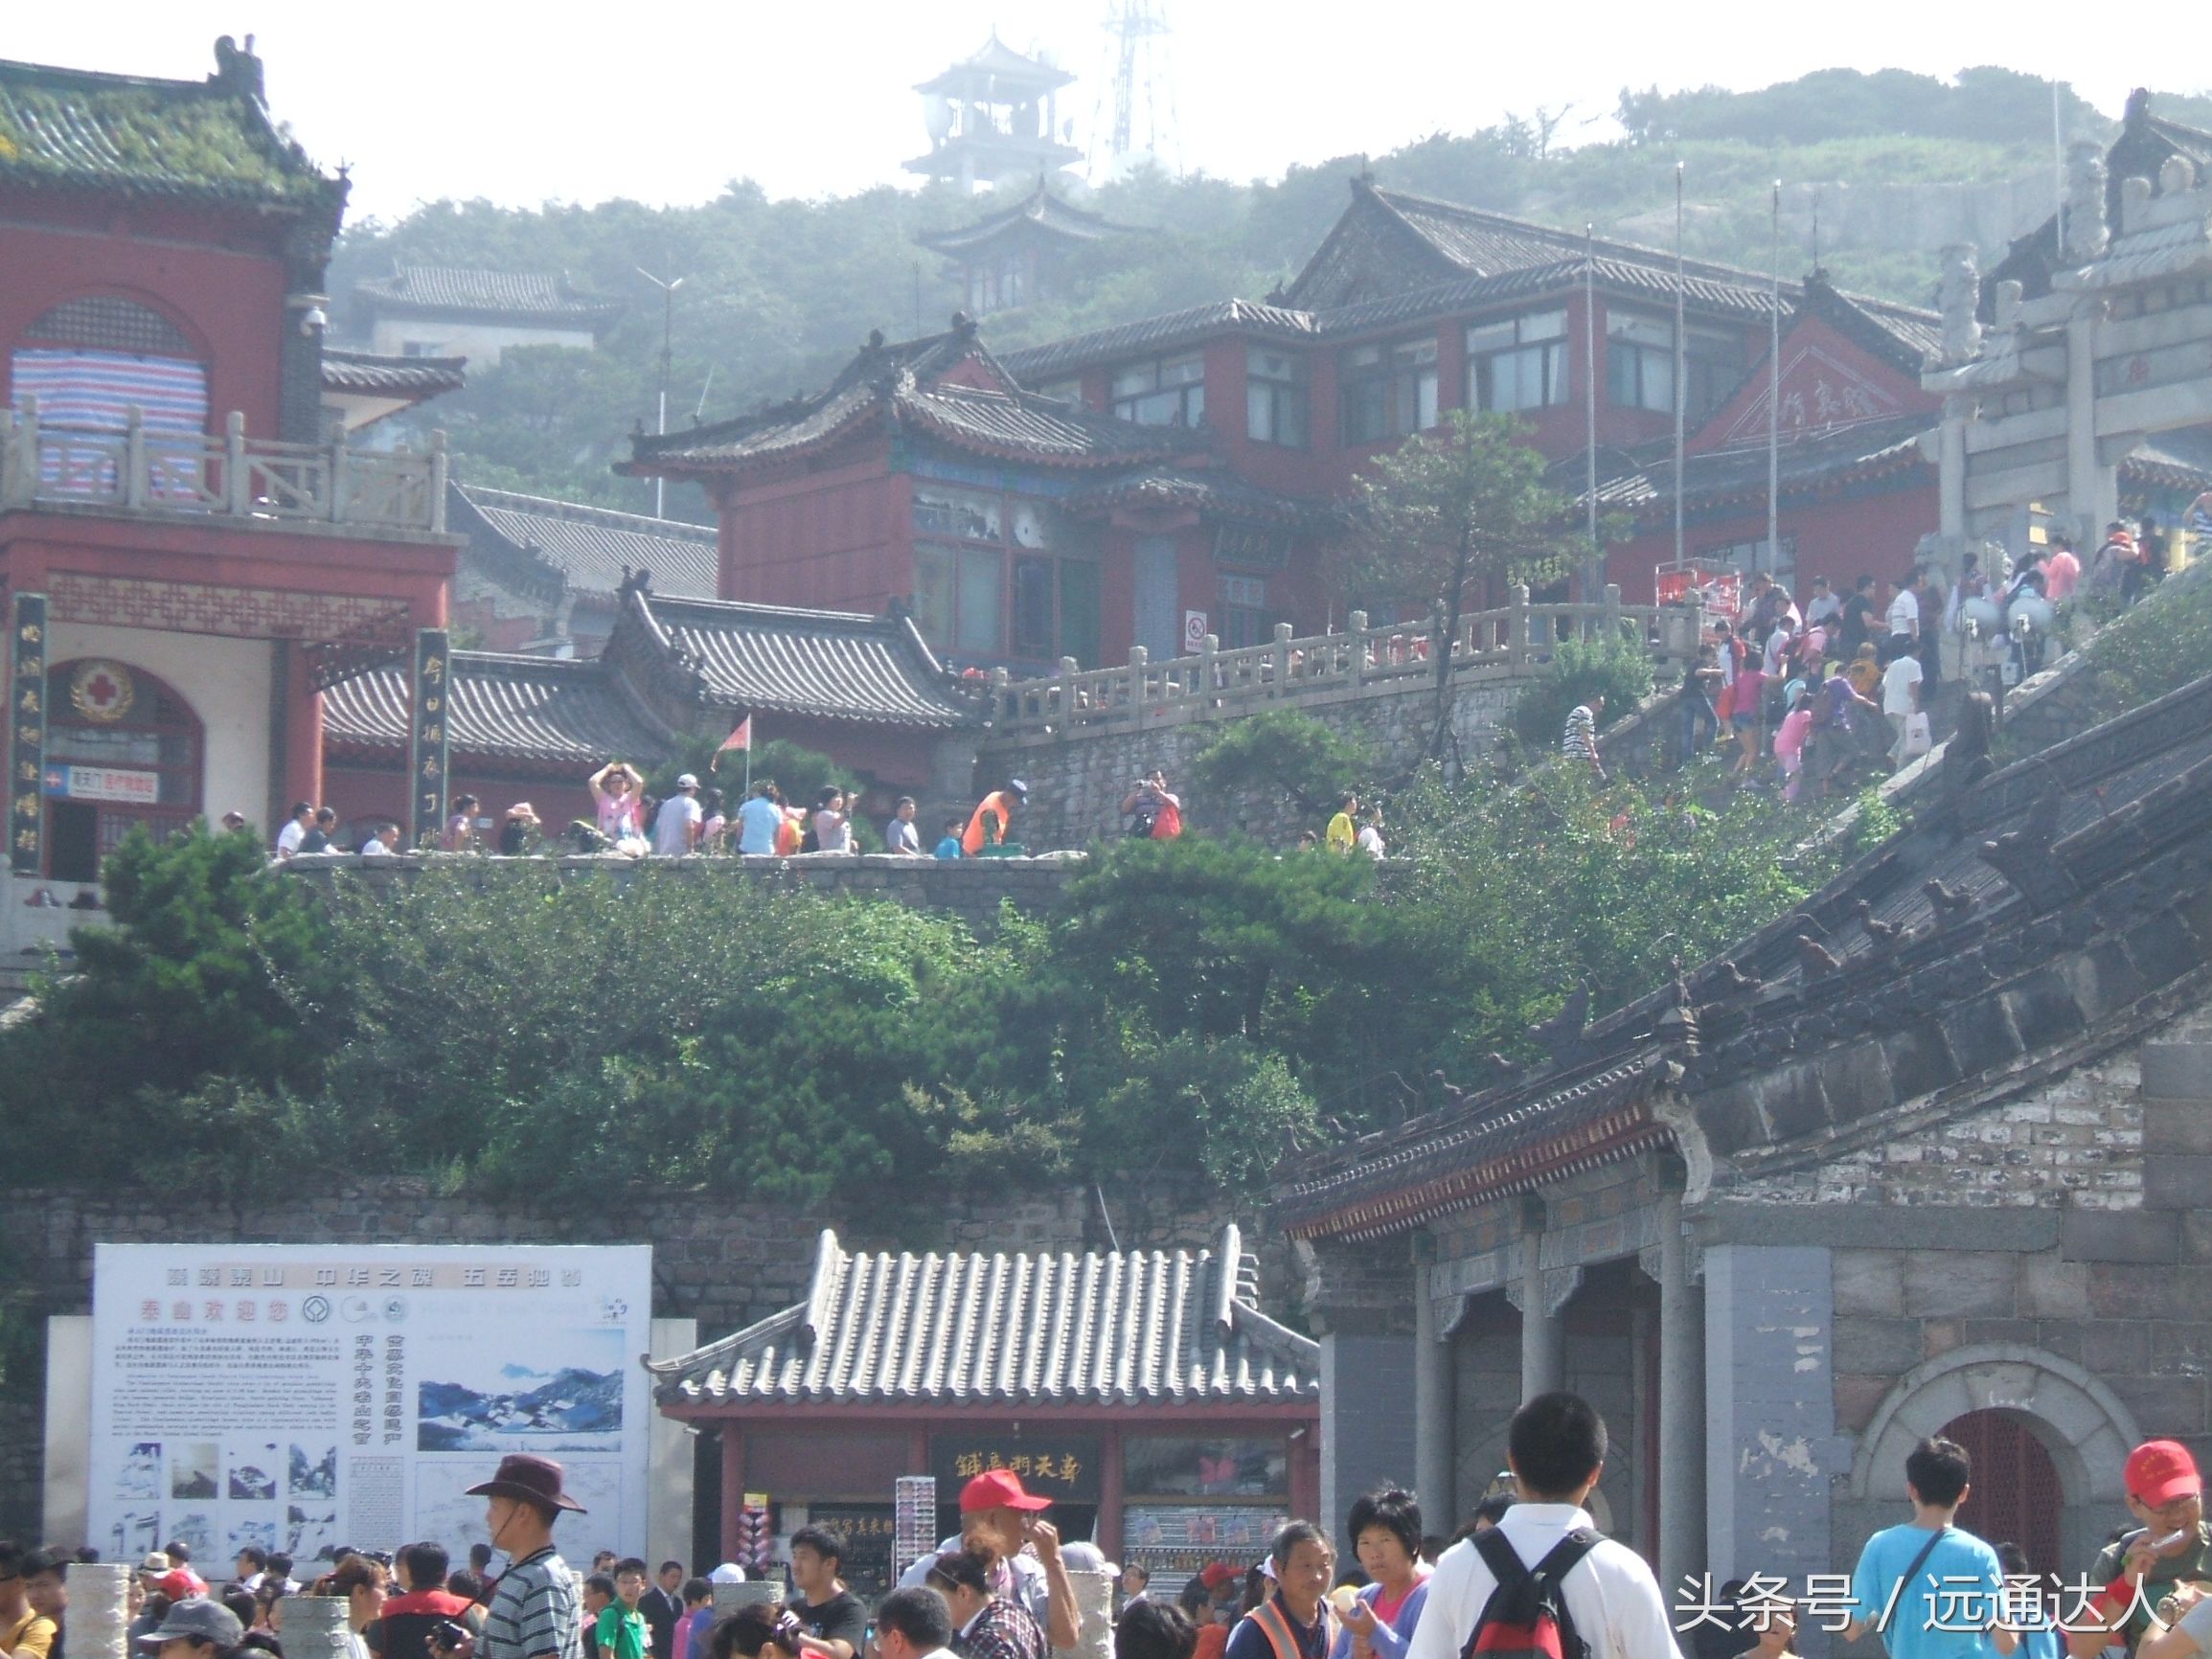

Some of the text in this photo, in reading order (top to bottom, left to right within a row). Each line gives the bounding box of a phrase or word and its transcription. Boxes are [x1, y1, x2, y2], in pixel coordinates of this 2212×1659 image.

[352, 1334, 374, 1445] 中华十大名山之首
[383, 1334, 404, 1445] 世界文化自然遗产
